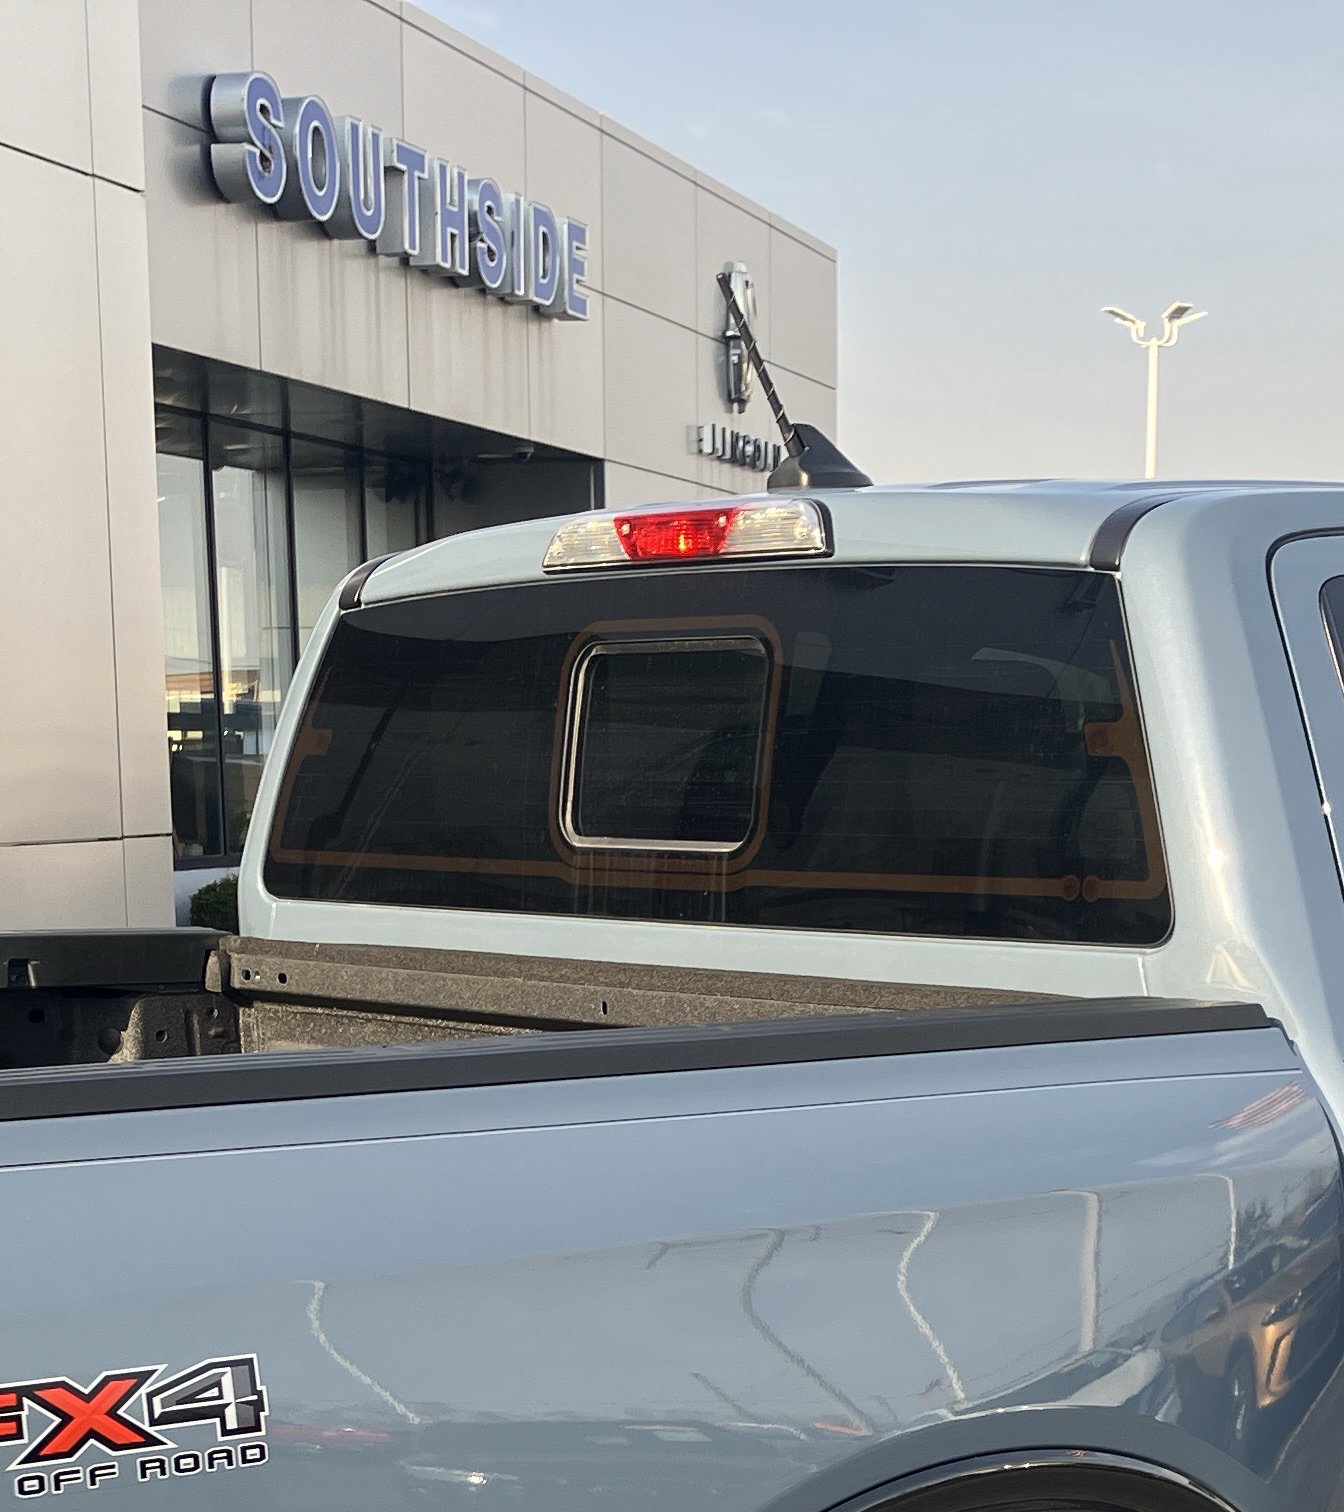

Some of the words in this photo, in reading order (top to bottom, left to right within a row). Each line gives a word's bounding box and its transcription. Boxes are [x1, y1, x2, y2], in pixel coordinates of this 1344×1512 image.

[231, 70, 590, 322] SOUTHSIDE
[14, 1460, 120, 1499] OFF
[136, 1441, 270, 1484] ROAD
